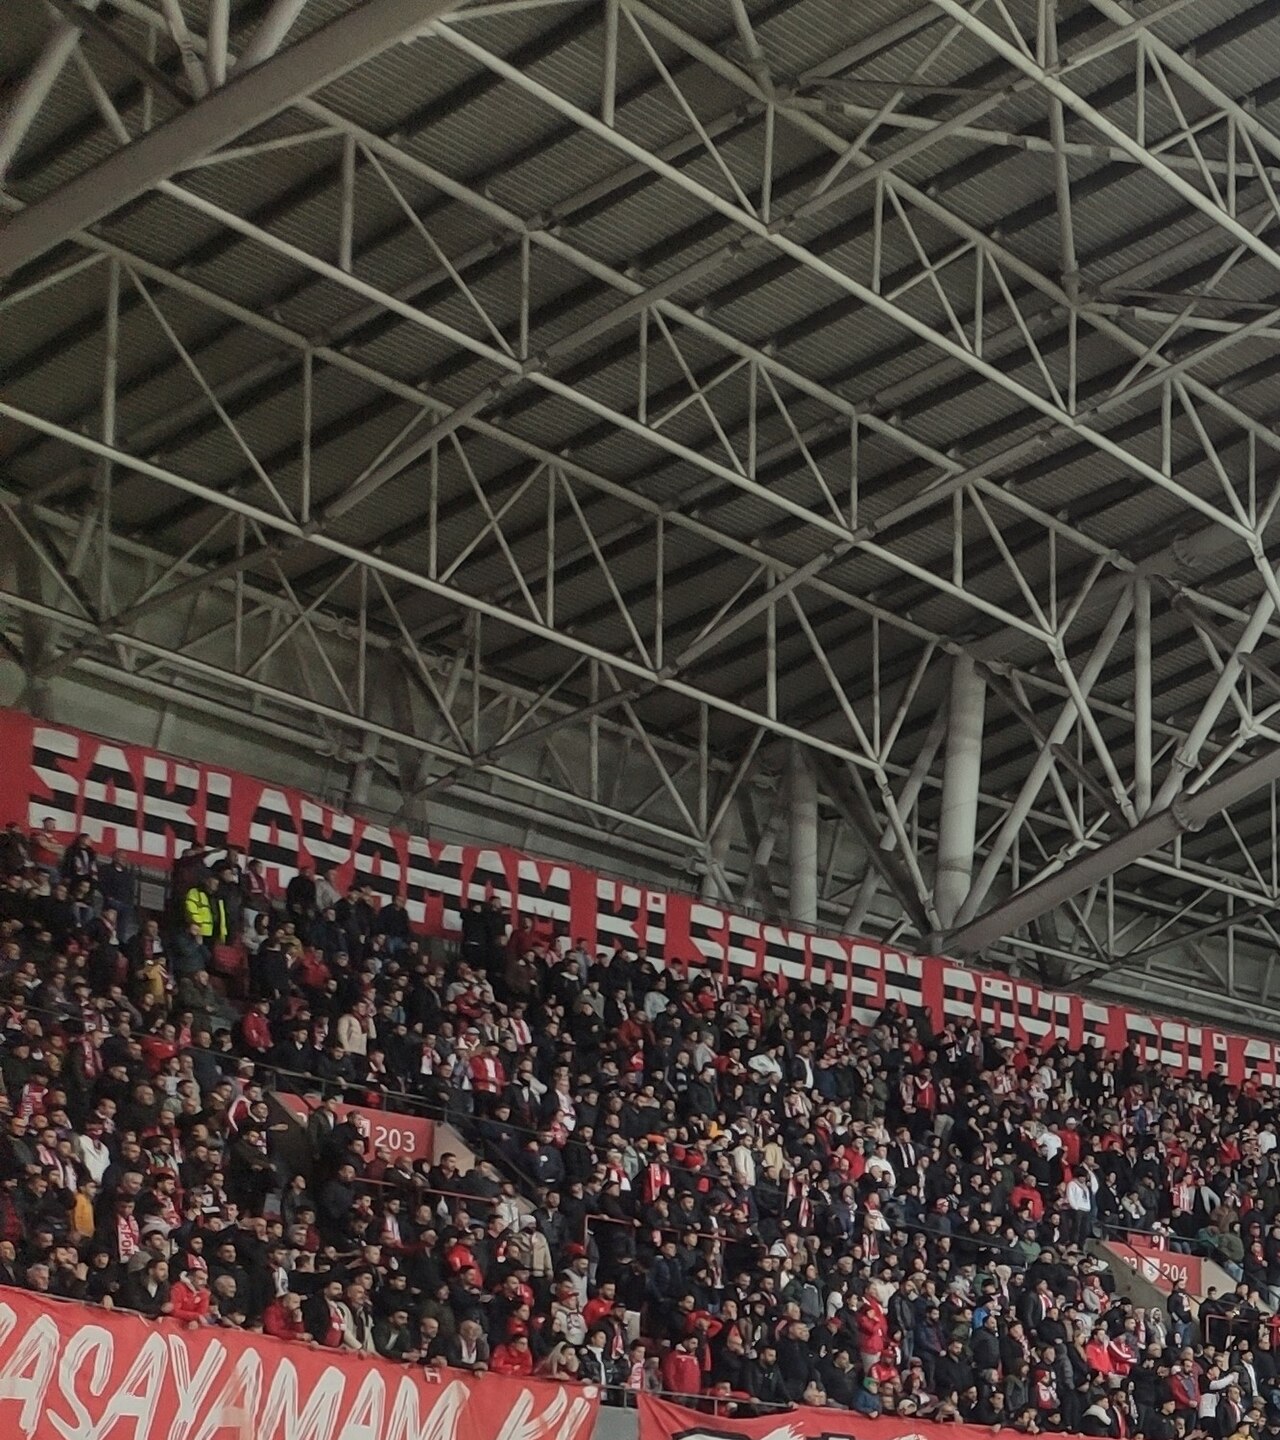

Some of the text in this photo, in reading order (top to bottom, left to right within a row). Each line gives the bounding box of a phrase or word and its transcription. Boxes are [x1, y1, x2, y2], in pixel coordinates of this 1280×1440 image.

[28, 727, 572, 952] SAKLAYAMAM
[688, 903, 923, 1030] SENDEN
[374, 1125, 416, 1152] 203
[1162, 1262, 1188, 1283] 204
